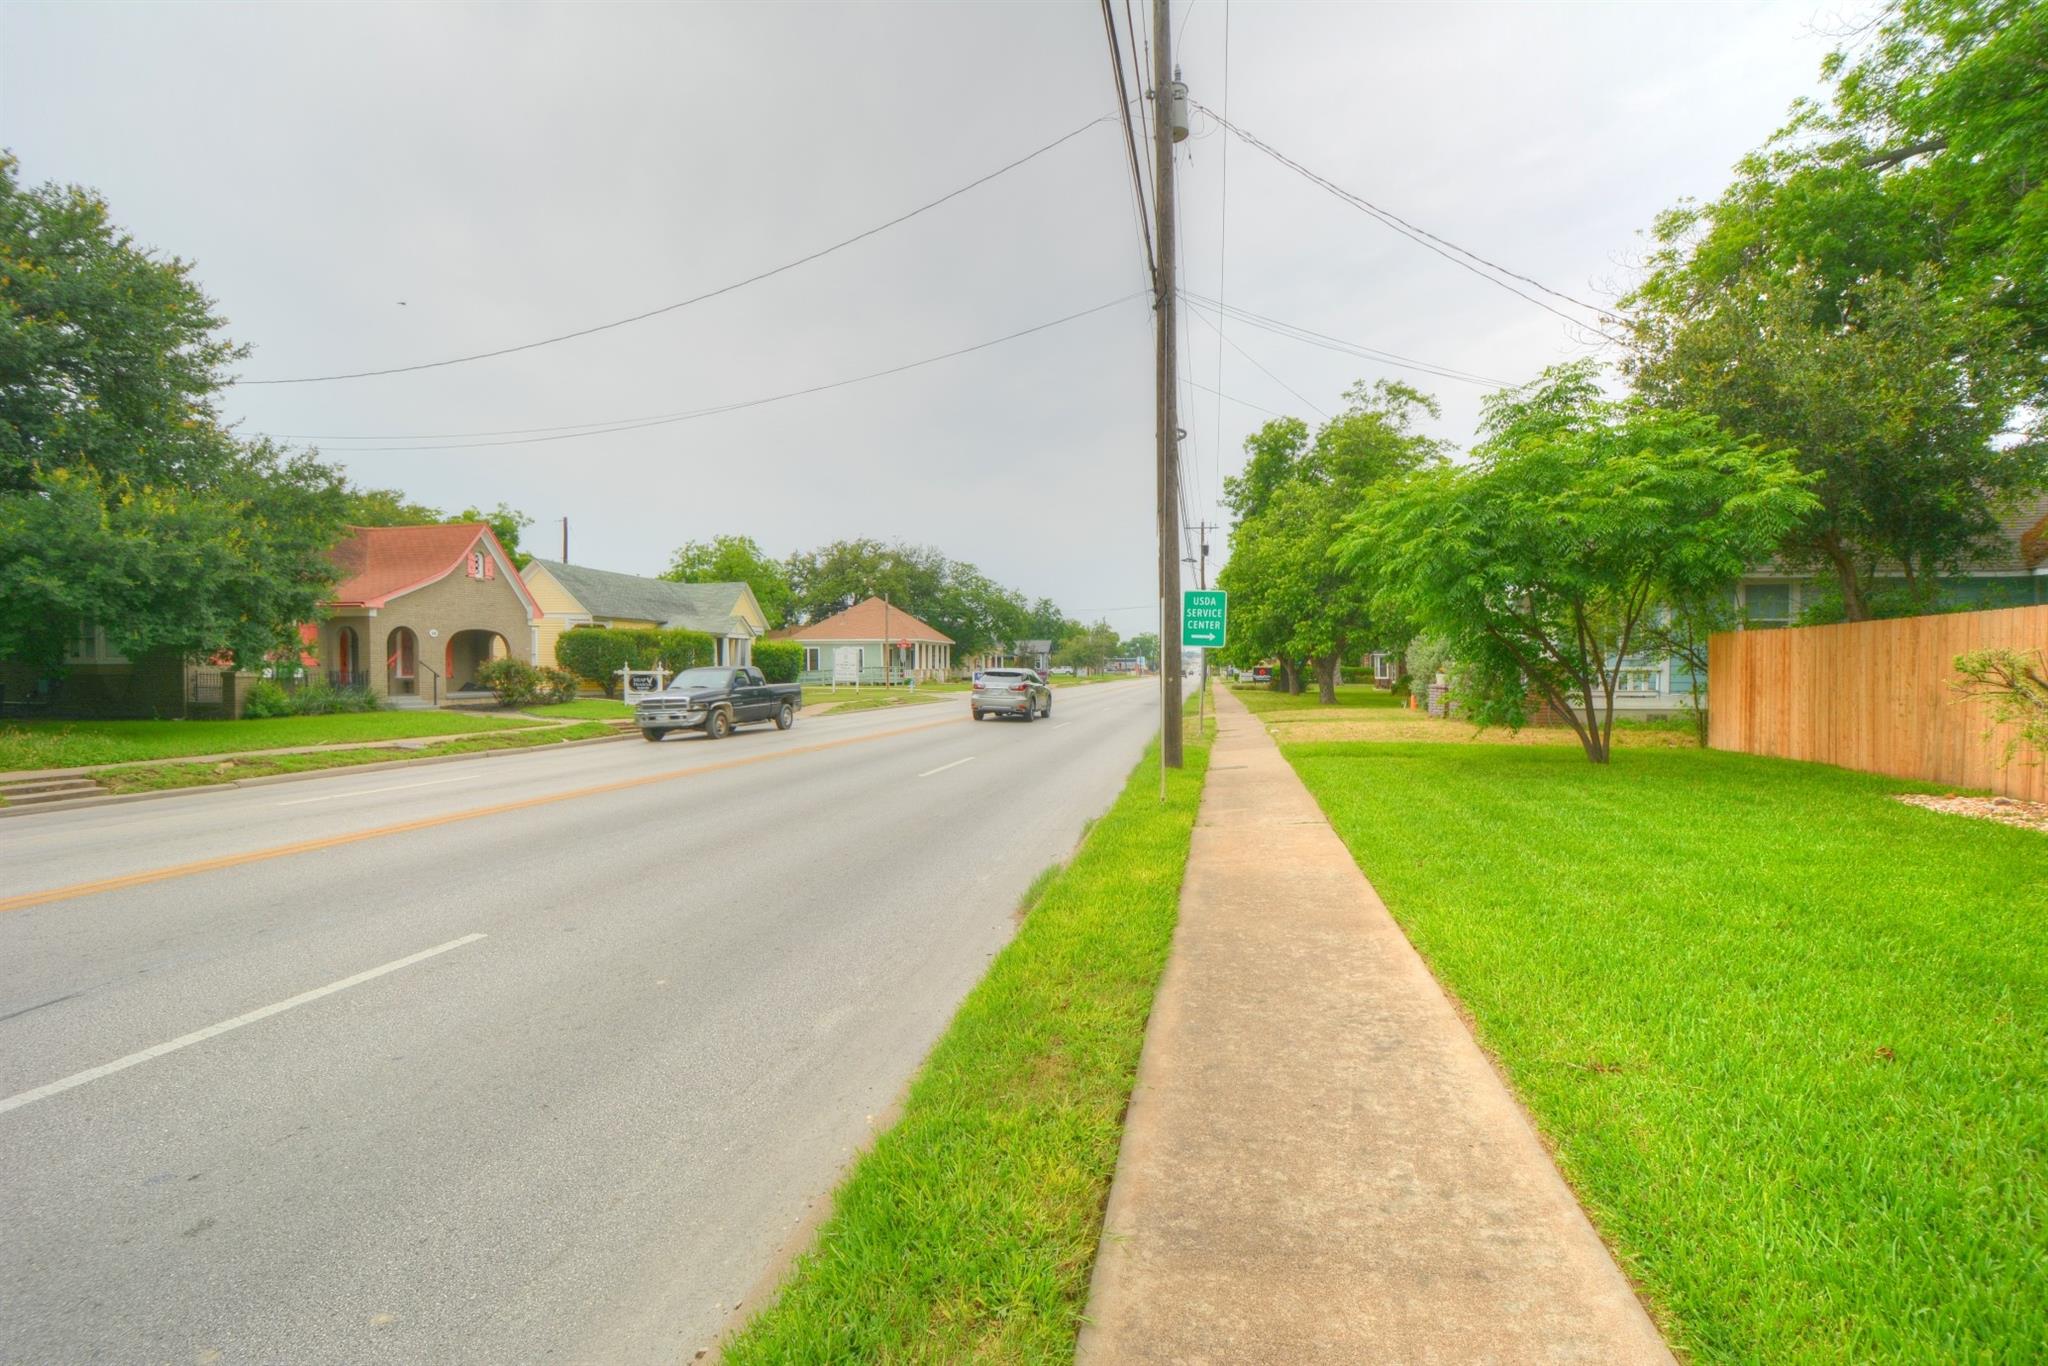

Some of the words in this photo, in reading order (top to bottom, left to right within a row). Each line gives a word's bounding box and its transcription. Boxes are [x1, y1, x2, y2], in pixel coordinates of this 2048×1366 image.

[1193, 596, 1216, 606] USDA
[1186, 608, 1222, 618] SERVICE
[1187, 620, 1221, 630] CENTER
